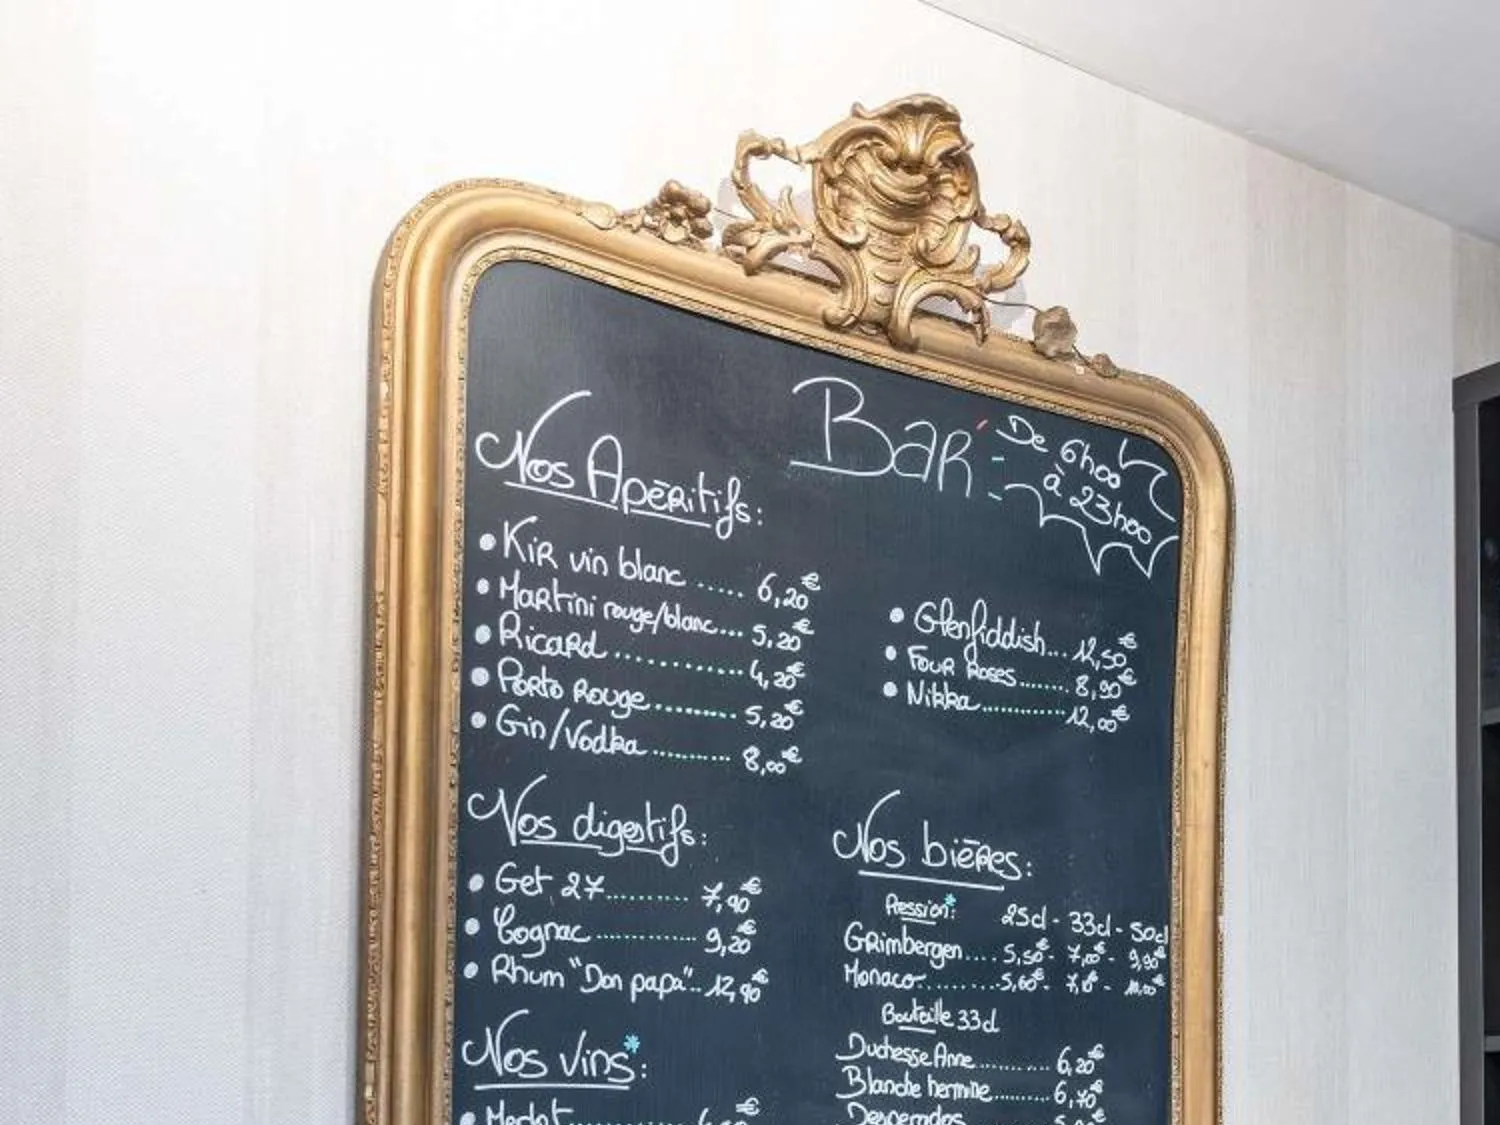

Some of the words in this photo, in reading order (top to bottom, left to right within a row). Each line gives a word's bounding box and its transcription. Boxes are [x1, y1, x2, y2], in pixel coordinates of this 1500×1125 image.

[476, 389, 592, 489] Nos
[997, 414, 1048, 453] De
[1043, 463, 1065, 498] à
[1060, 439, 1120, 489] 6h00
[1069, 486, 1152, 544] 23h00
[570, 548, 608, 577] vin
[619, 545, 687, 588] blanc
[604, 601, 718, 635] rouge/blanc
[907, 680, 980, 710] Nikka
[468, 774, 557, 846] Nos
[833, 789, 906, 868] Nos
[495, 861, 553, 896] Get
[561, 871, 605, 900] 27
[493, 903, 592, 958] Cognac
[1001, 903, 1047, 931] 25cl
[1069, 911, 1111, 938] 33cl
[491, 953, 564, 988] Rhum
[844, 959, 927, 989] Monaco
[462, 1009, 548, 1077] Nos
[835, 1033, 933, 1068] Duchesse
[934, 1041, 975, 1070] Anne
[835, 1064, 923, 1099] Blanche
